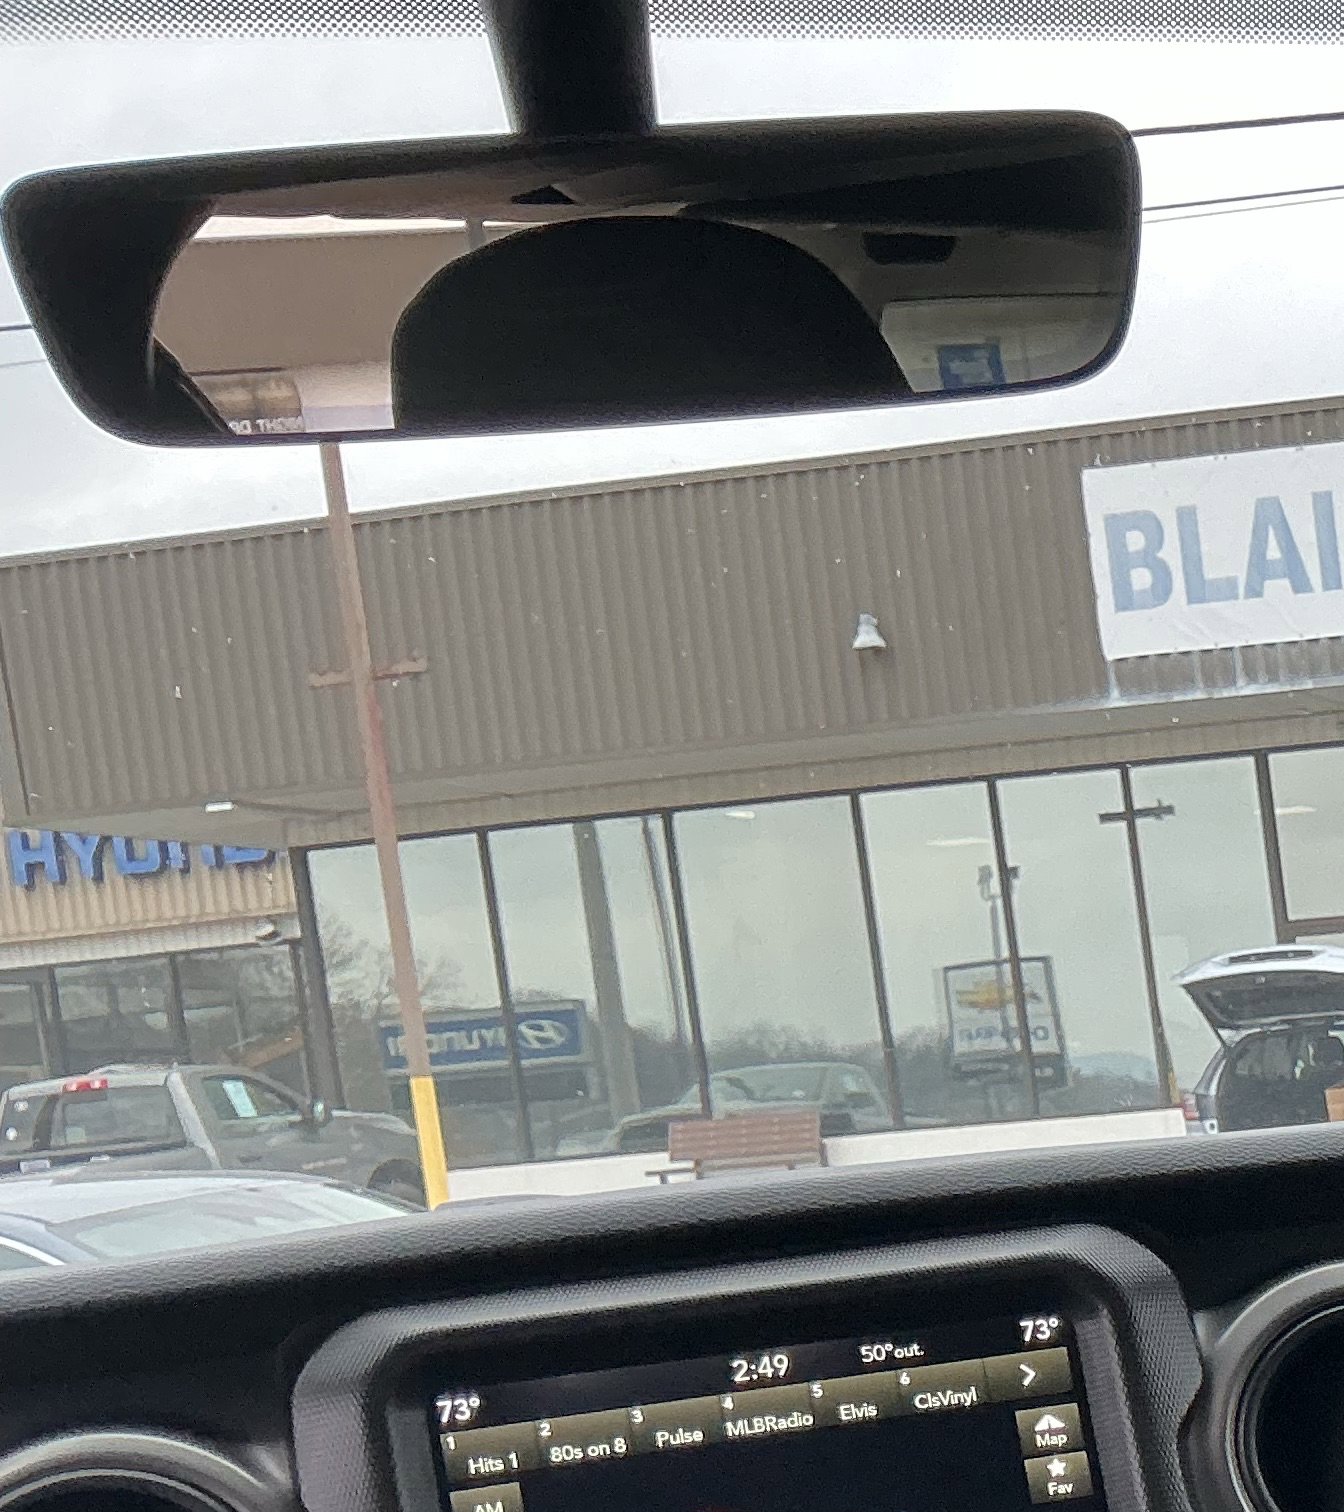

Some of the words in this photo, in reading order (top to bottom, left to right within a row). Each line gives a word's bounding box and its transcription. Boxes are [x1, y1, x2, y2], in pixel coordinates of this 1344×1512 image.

[731, 1354, 789, 1383] 2:49
[900, 1371, 911, 1386] 6
[810, 1383, 824, 1399] 5
[721, 1396, 735, 1410] 4
[631, 1409, 645, 1424] 3
[839, 1403, 879, 1422] Elvis
[539, 1422, 552, 1438] 2
[724, 1409, 815, 1438] MLBRadio
[446, 1437, 456, 1451] 1
[655, 1426, 704, 1449] Pulse
[1034, 1433, 1068, 1449] Map
[550, 1444, 584, 1463] 80s
[587, 1442, 611, 1459] on
[613, 1438, 628, 1454] 8
[467, 1455, 505, 1475] Hits
[508, 1451, 519, 1470] 1
[1047, 1481, 1074, 1496] Fav
